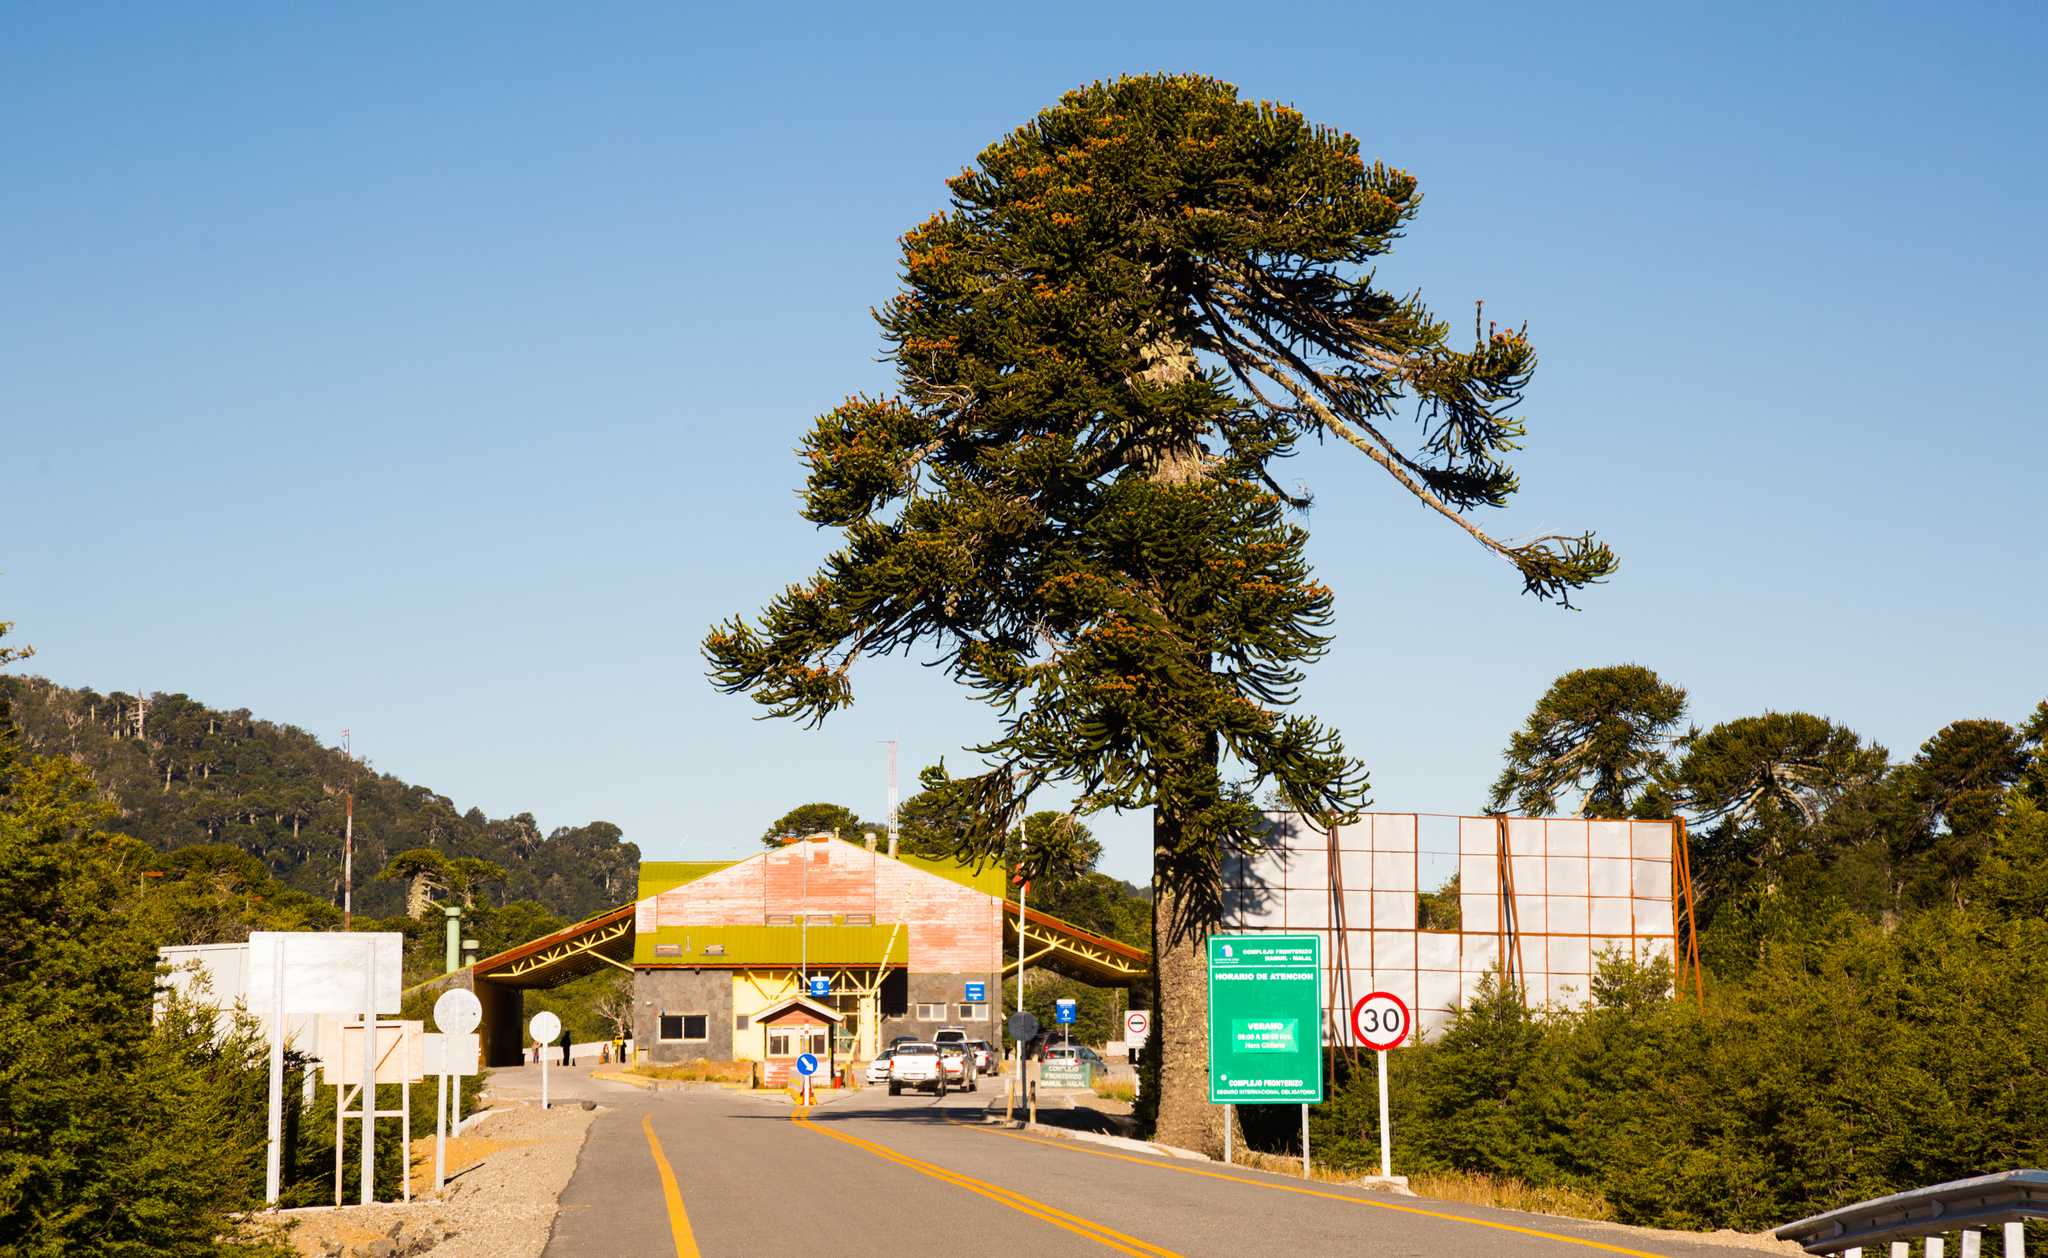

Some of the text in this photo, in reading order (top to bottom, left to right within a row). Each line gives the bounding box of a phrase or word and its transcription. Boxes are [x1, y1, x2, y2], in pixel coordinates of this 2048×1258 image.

[1363, 1008, 1399, 1033] 30
[1247, 1022, 1284, 1030] VERANO
[1229, 1079, 1304, 1087] COMPLEJO FRONTERIZO
